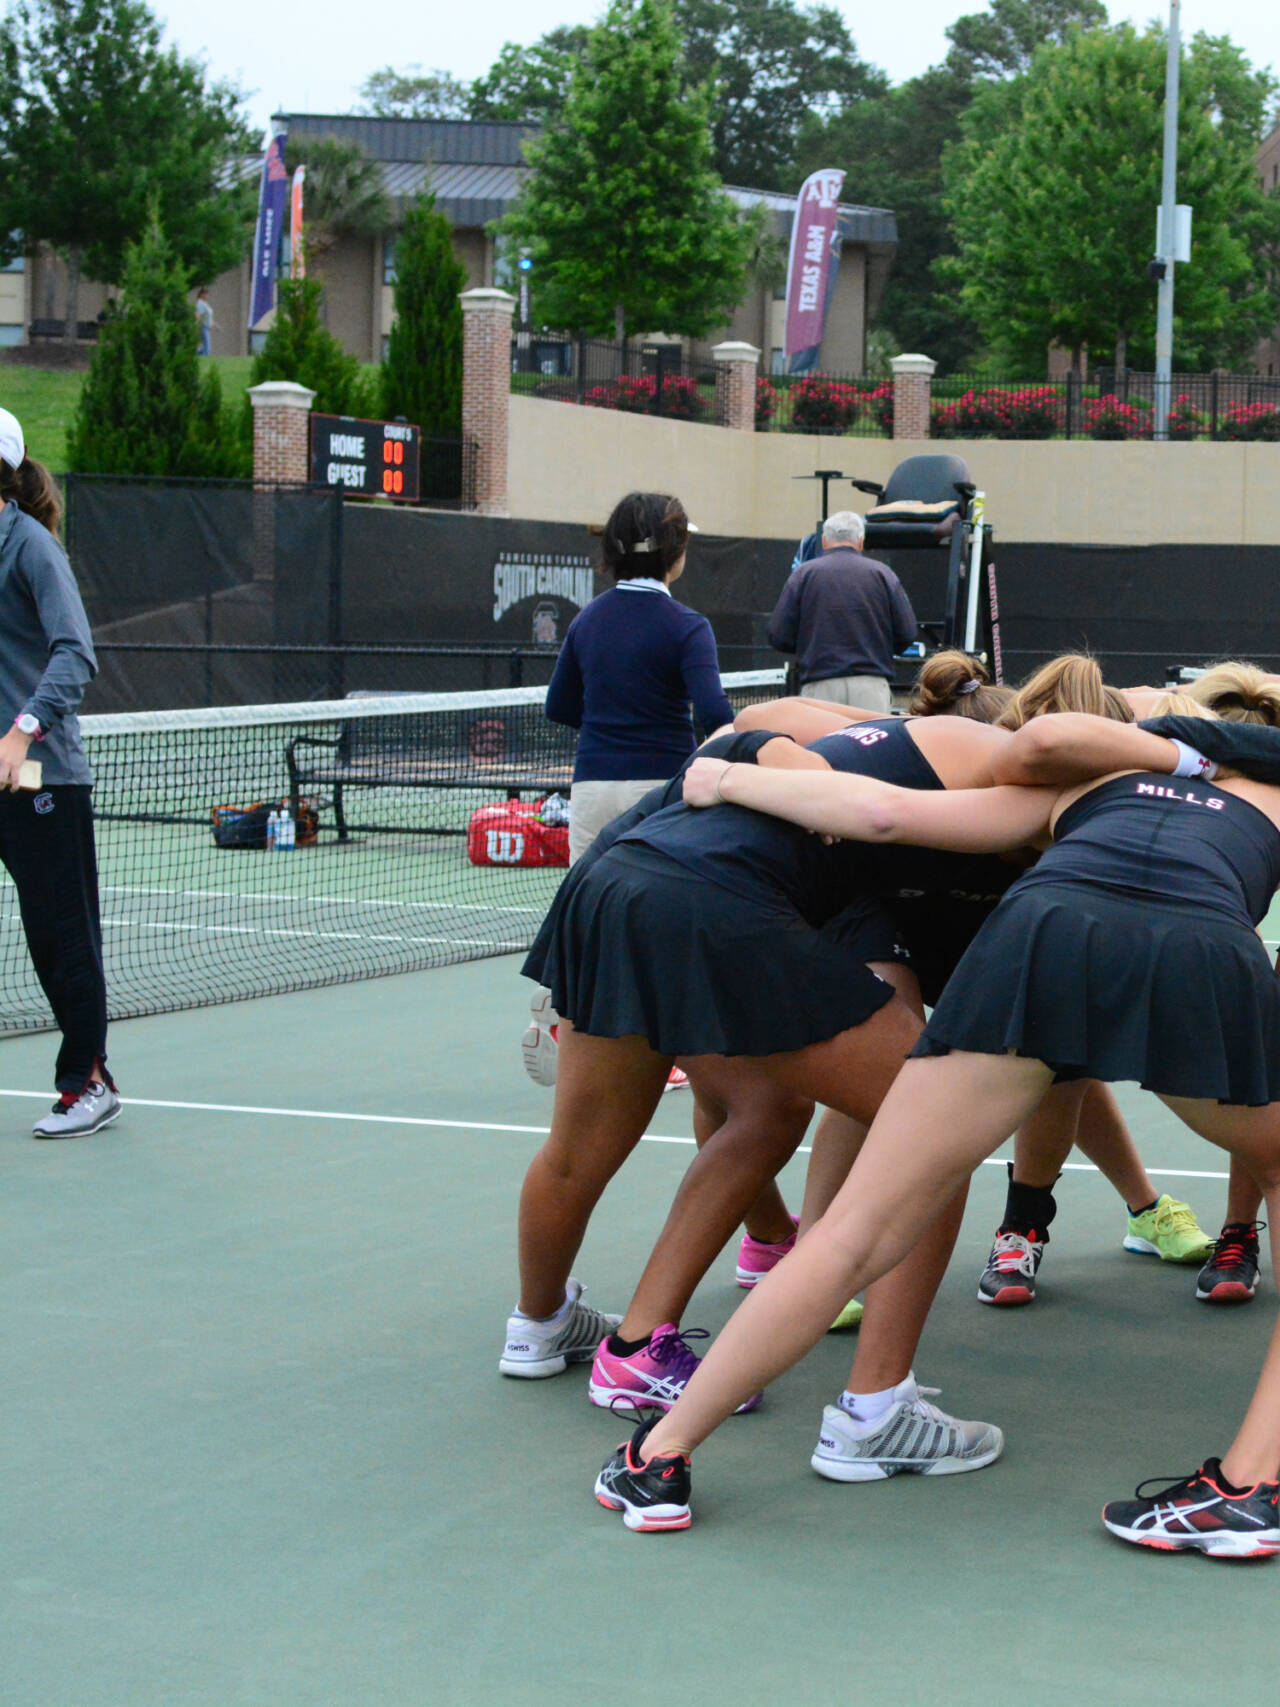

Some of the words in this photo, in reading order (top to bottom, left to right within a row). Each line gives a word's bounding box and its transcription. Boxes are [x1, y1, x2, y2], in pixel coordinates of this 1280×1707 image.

[804, 225, 826, 263] A&M
[798, 265, 821, 312] TEXAS
[329, 434, 365, 459] HOME
[327, 462, 367, 488] GUEST
[493, 563, 536, 622] SOUTH
[536, 565, 594, 610] CAROLINA
[1137, 783, 1225, 810] MILLS
